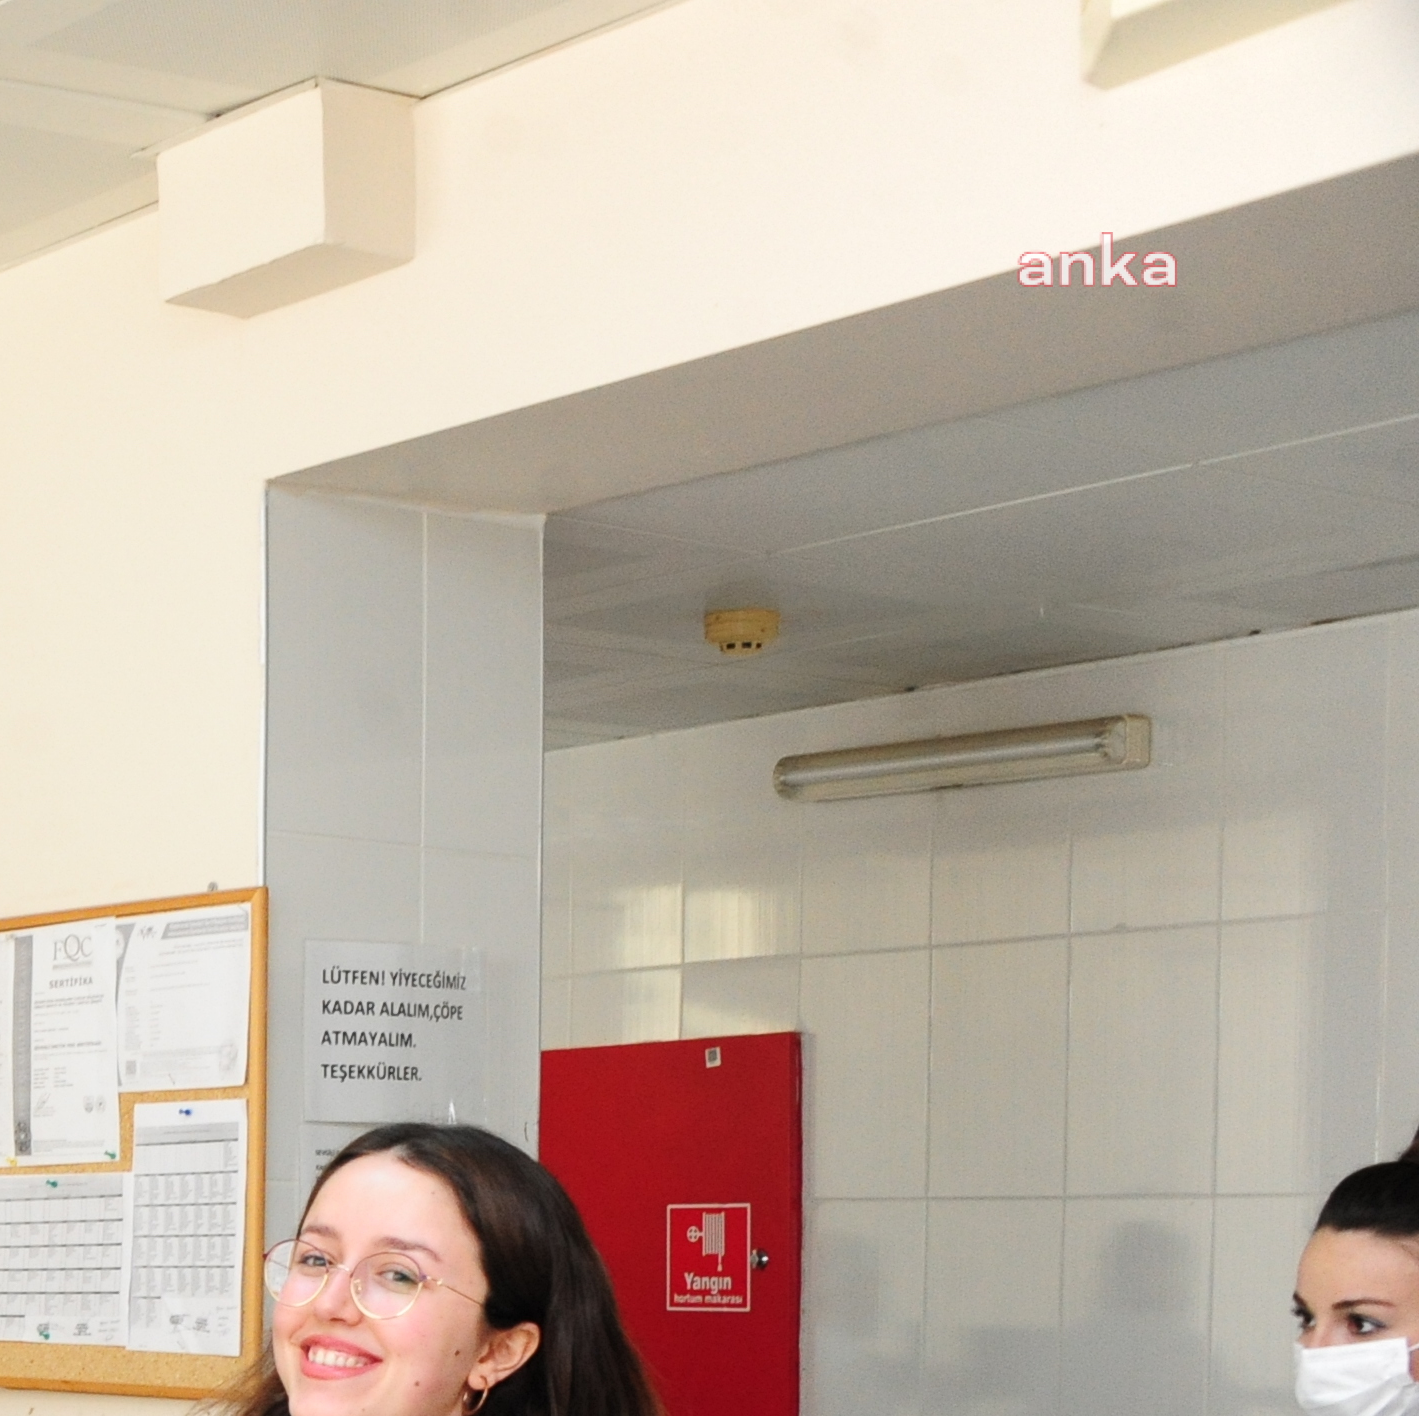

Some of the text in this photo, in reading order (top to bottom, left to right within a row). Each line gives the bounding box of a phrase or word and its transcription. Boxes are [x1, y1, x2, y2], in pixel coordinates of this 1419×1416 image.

[321, 966, 467, 991] LÜTFEN! YİYECEĞİMİZ
[321, 999, 464, 1022] KADAR ALALIM,ÇÖPE
[320, 1030, 417, 1049] ATMAYALIM.
[320, 1062, 423, 1084] TEŞEKKÜRLER.
[684, 1271, 732, 1295] Yangın
